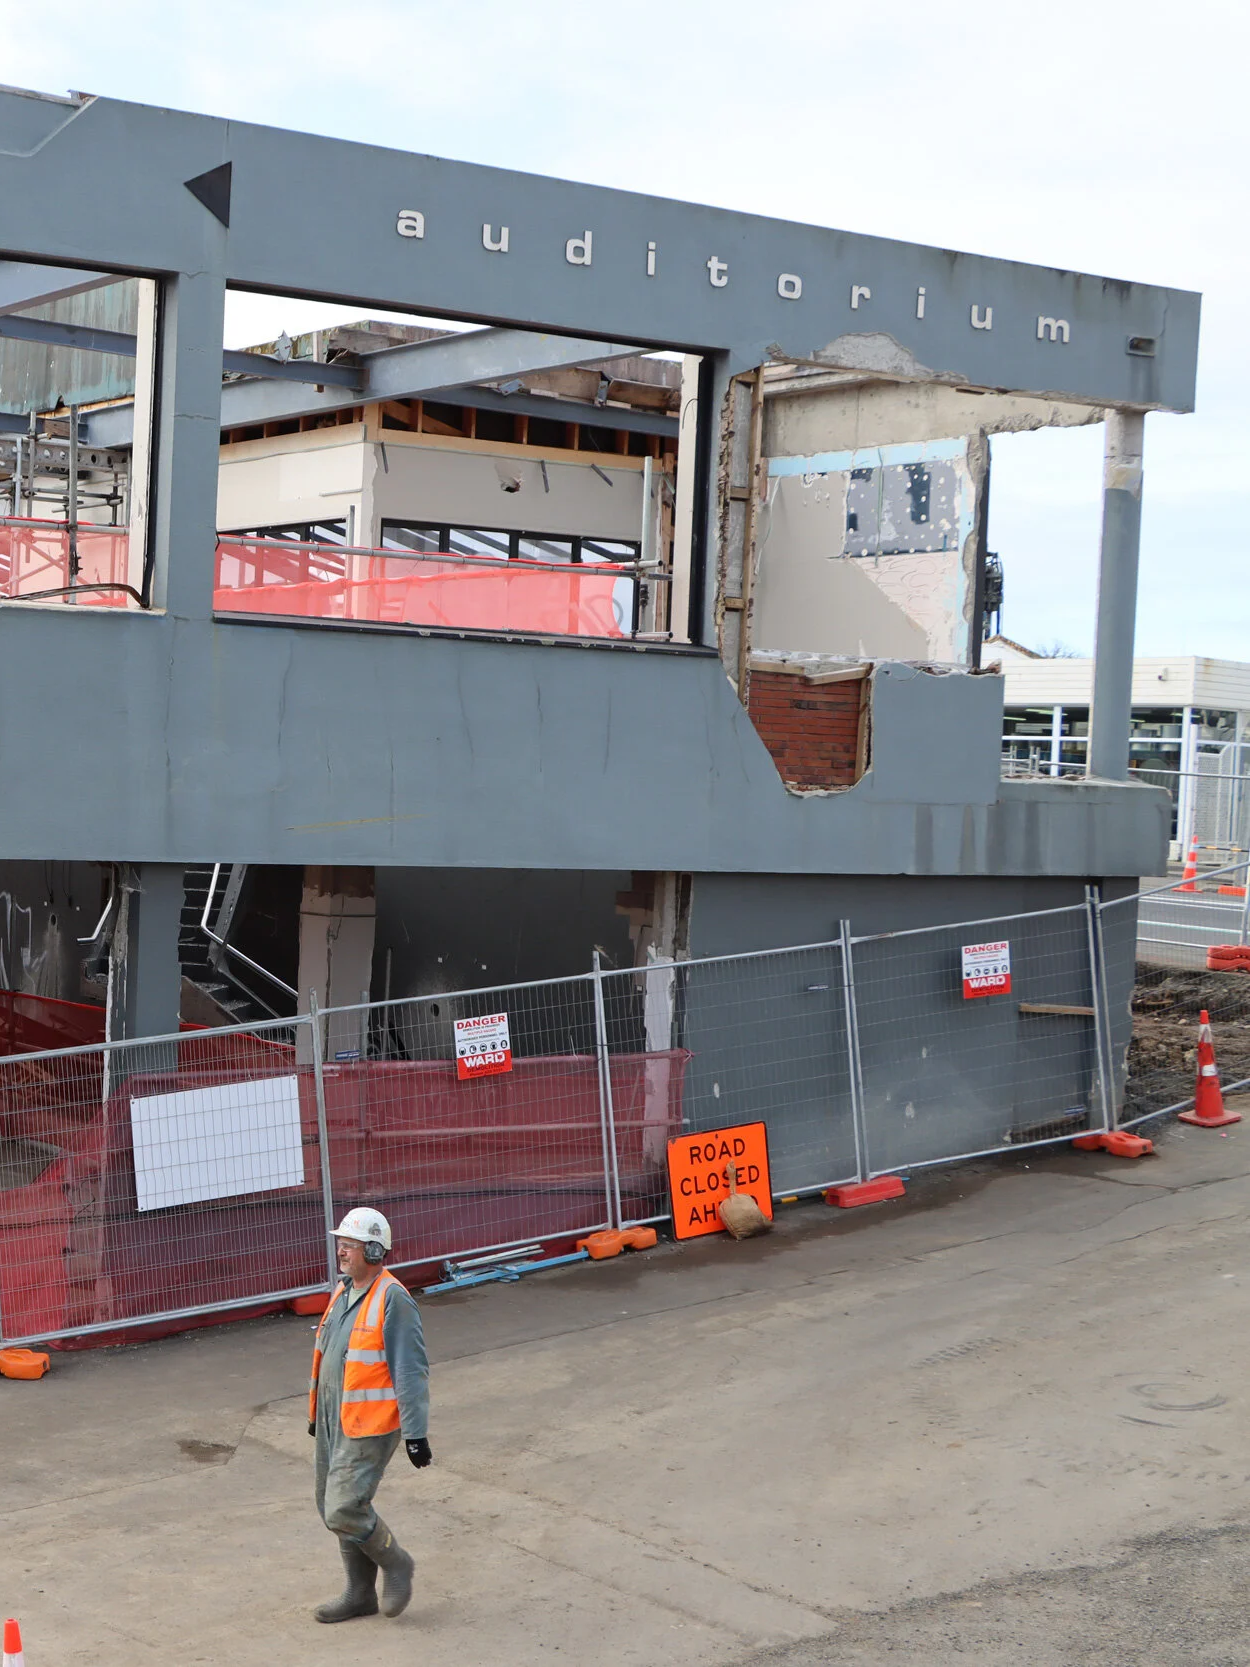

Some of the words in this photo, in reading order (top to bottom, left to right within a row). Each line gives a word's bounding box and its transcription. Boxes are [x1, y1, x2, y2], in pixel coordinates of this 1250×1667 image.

[396, 207, 1071, 345] auditorium
[964, 943, 1007, 954] DANGER
[968, 975, 1006, 988] WARD
[456, 1015, 506, 1030] DANGER
[463, 1051, 506, 1068] WARD
[689, 1138, 746, 1165] ROAD
[680, 1165, 760, 1196] CLOSED
